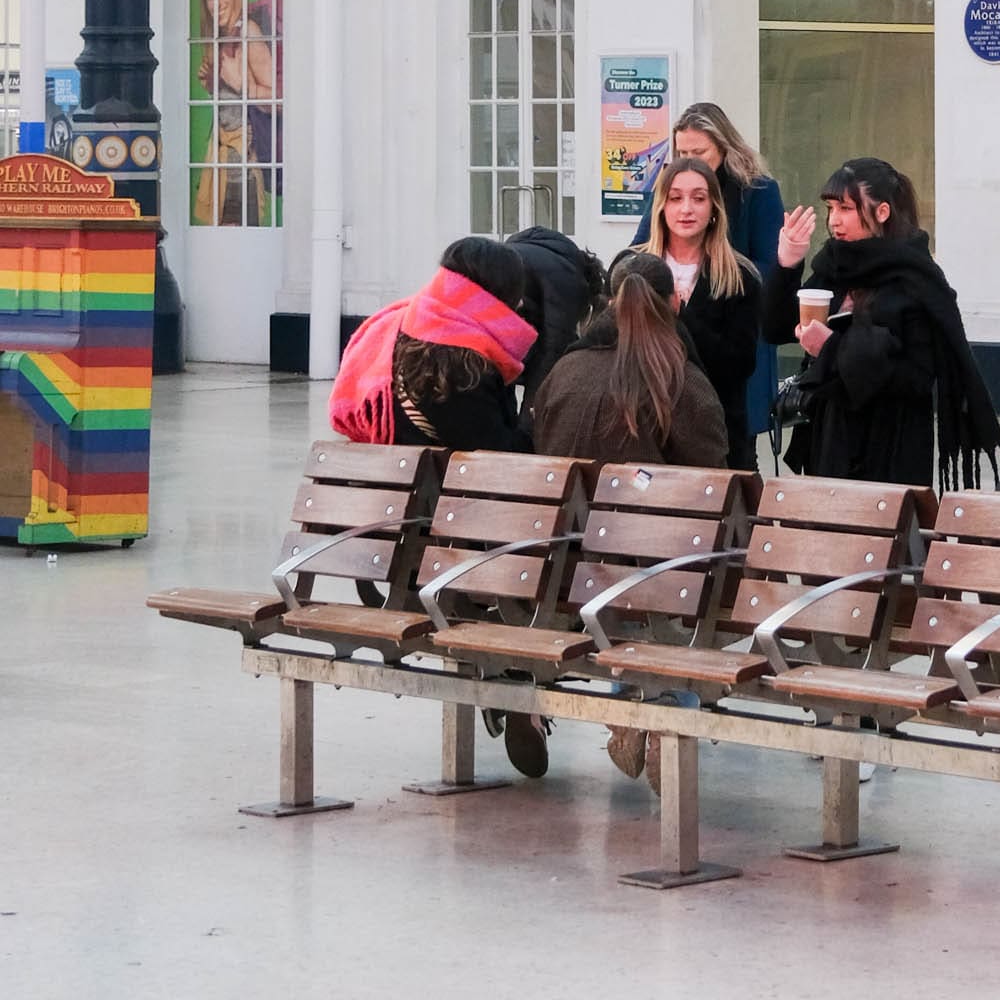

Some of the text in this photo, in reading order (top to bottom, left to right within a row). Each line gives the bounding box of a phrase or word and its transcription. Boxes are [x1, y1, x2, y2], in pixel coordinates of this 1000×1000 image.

[608, 80, 664, 92] Turner Prize
[634, 96, 659, 108] 2023
[42, 163, 71, 183] ME
[43, 183, 105, 194] RAILWAY
